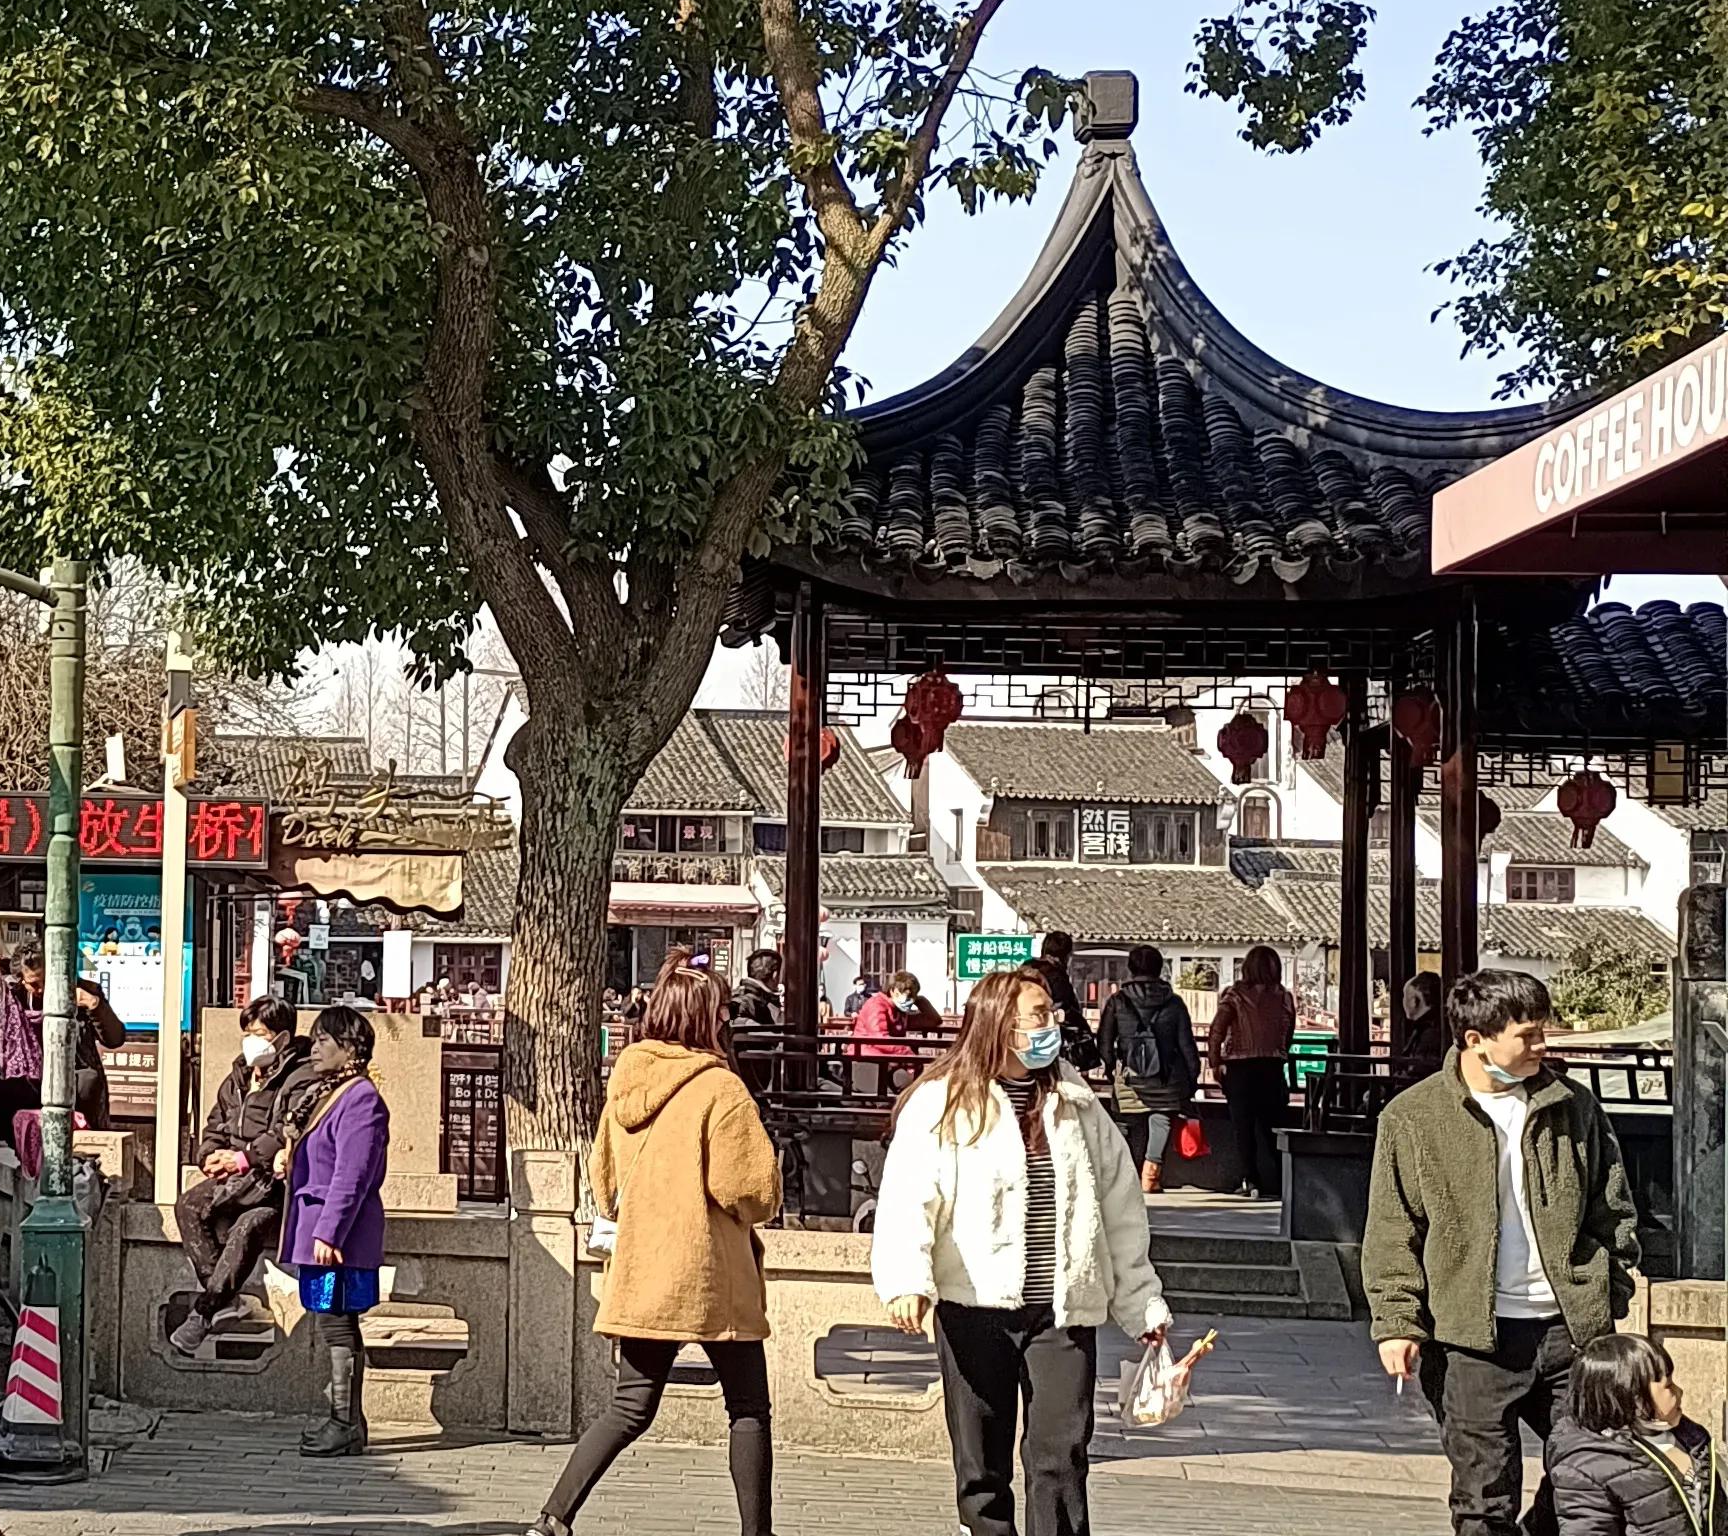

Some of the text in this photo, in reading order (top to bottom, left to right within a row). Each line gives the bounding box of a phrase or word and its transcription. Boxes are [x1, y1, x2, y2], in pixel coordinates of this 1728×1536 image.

[1534, 347, 1728, 513] COFFEE HOU
[1082, 809, 1130, 832] 然后
[1082, 833, 1130, 856] 客栈
[967, 940, 1028, 956] 游船码头
